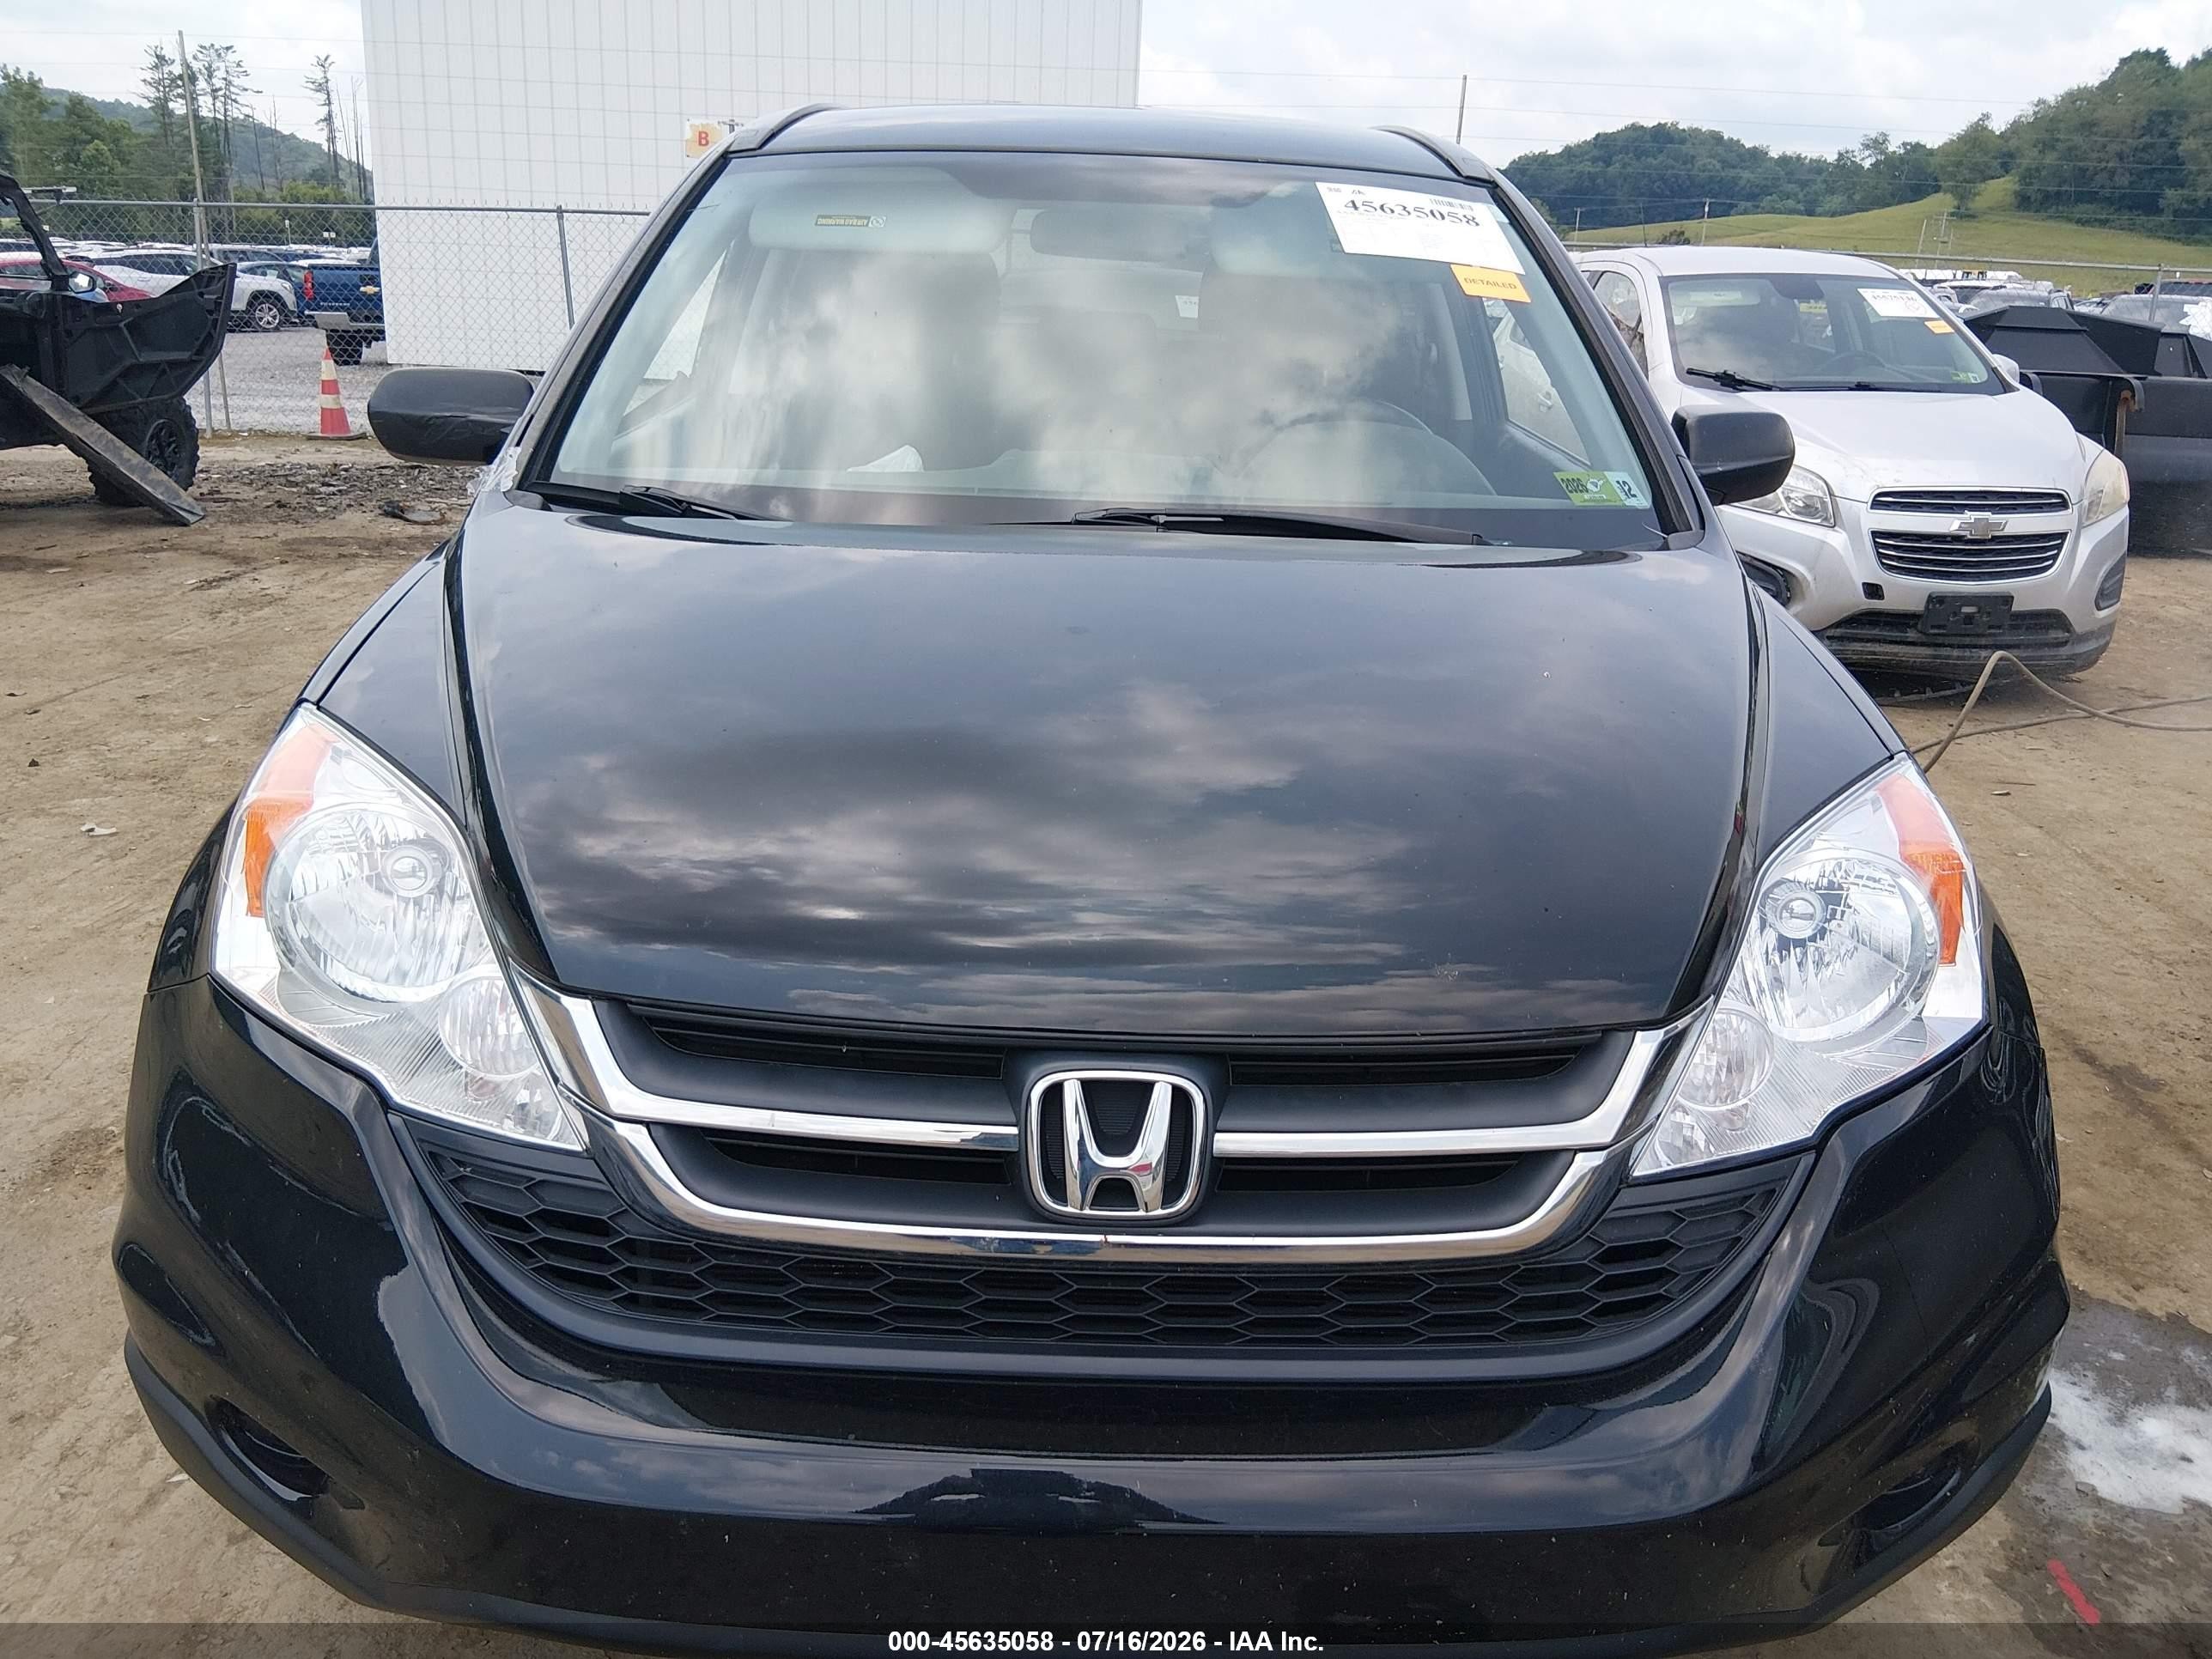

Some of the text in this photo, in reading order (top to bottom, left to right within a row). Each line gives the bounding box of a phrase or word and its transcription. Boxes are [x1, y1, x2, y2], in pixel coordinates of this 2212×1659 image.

[697, 131, 710, 147] B
[1344, 199, 1480, 227] 45635058
[1463, 276, 1517, 290] DETAILED
[1560, 477, 1589, 495] 2026
[1616, 480, 1638, 499] 12
